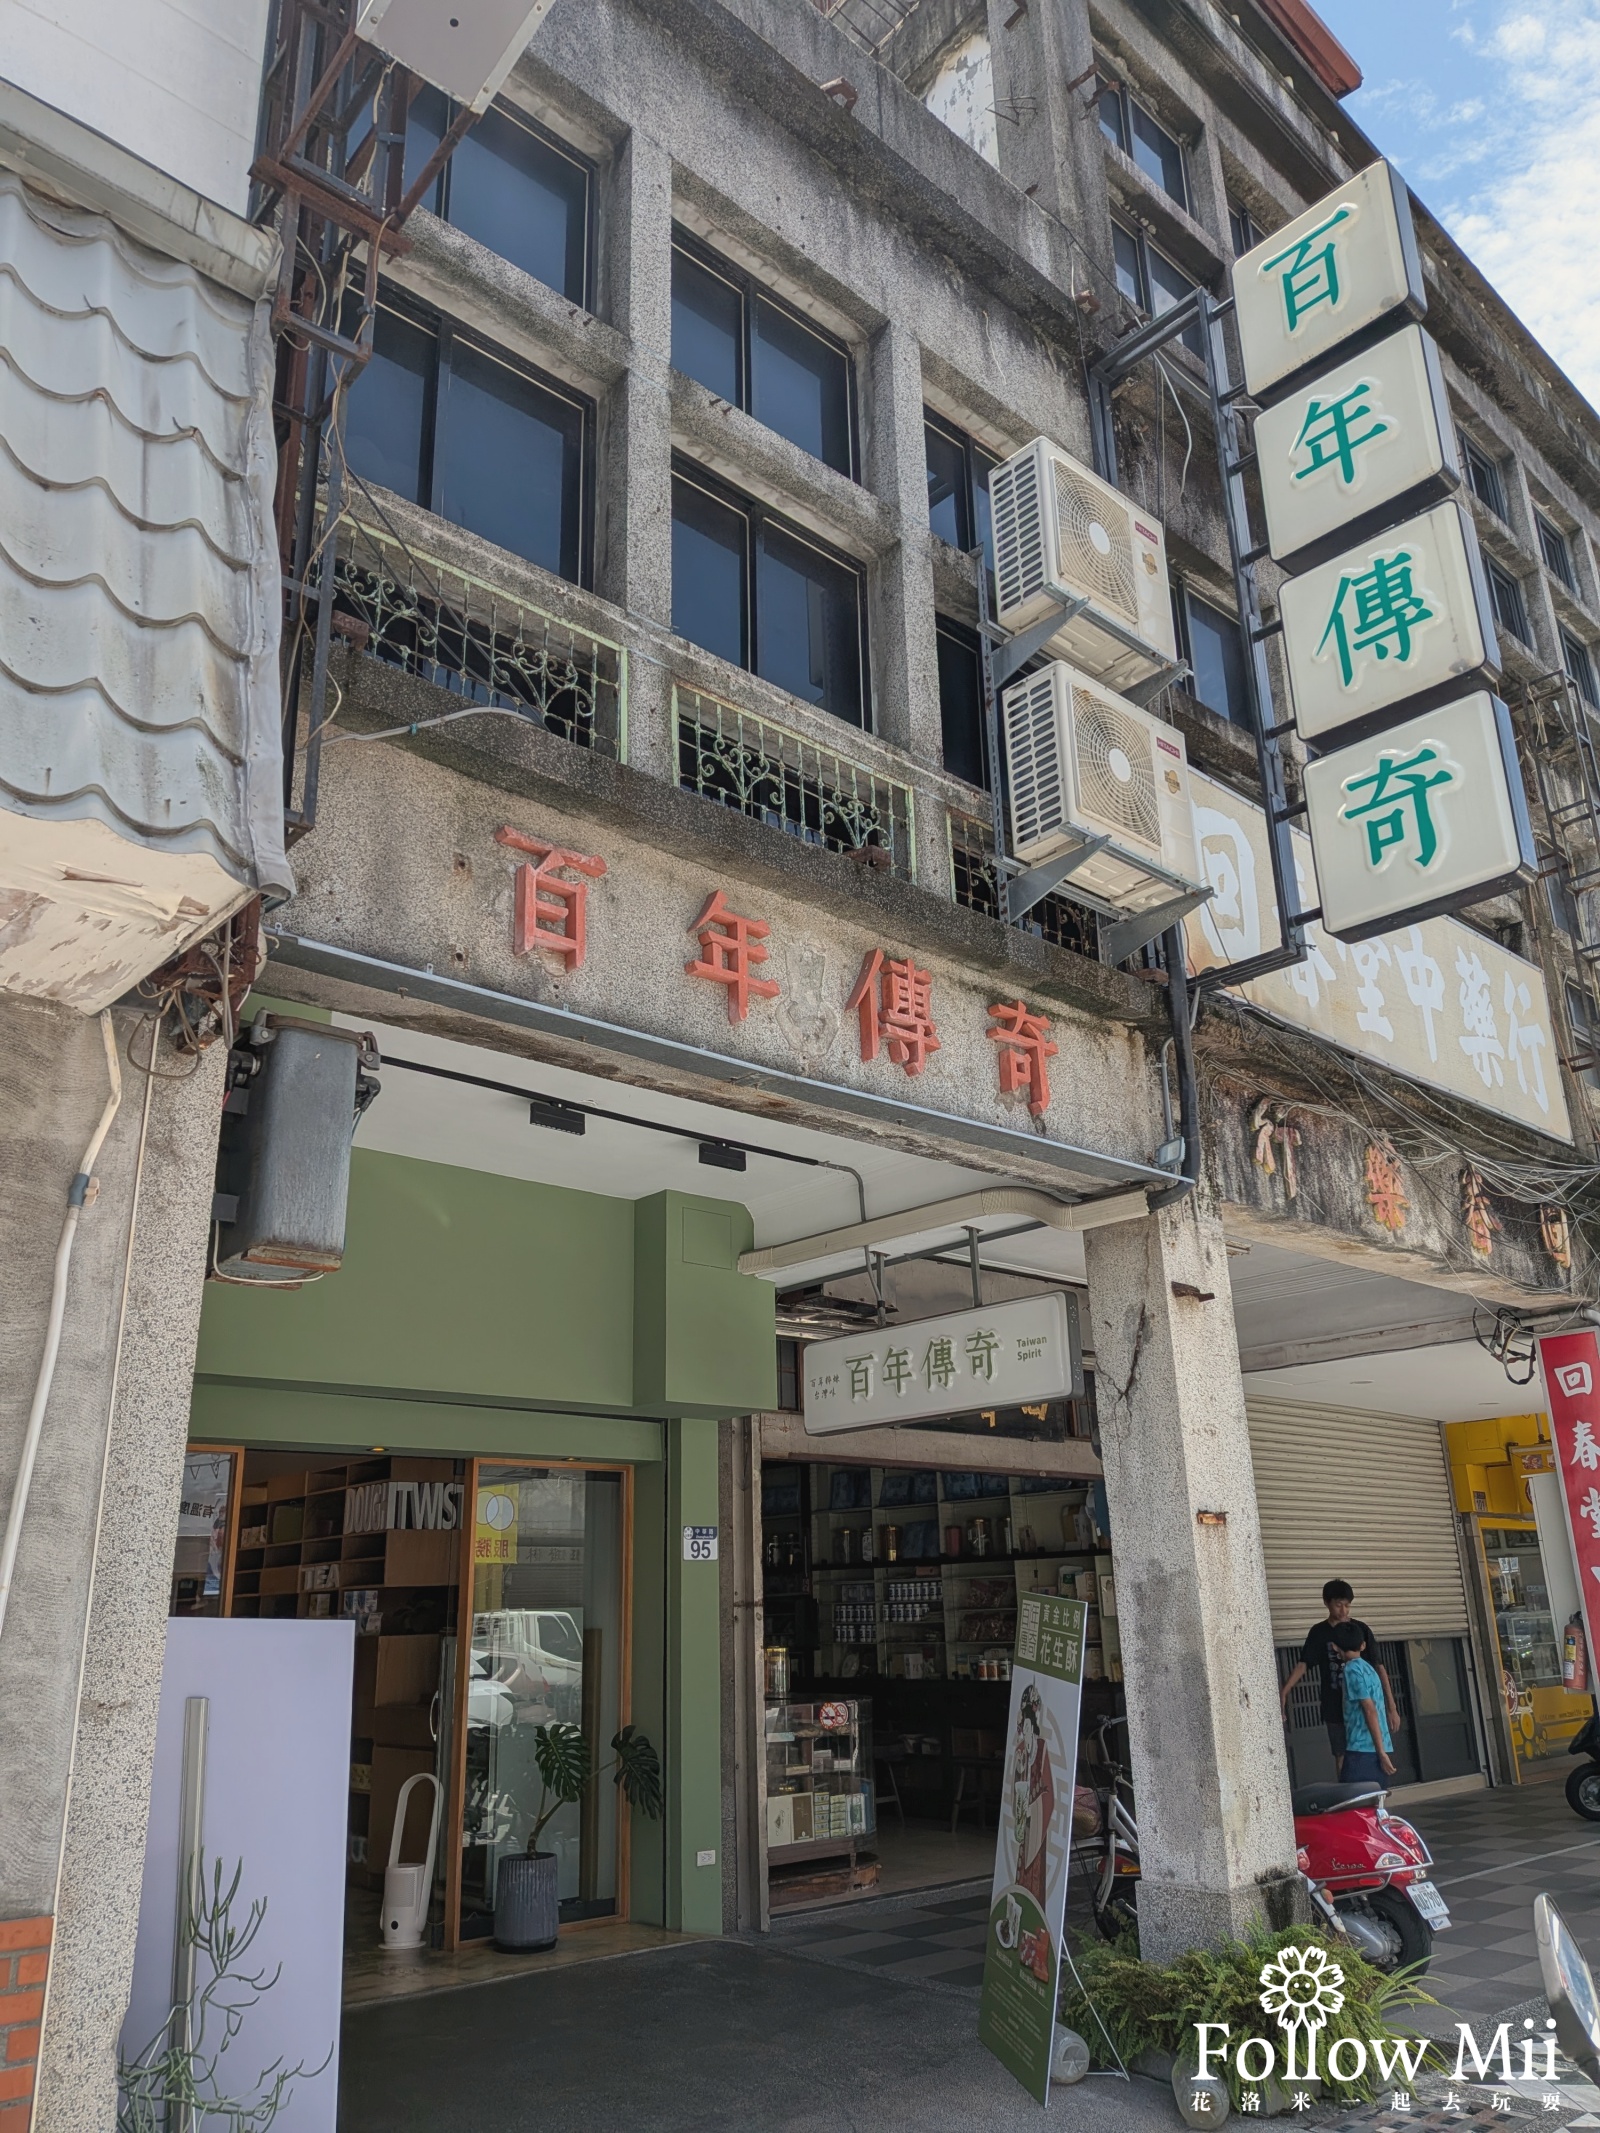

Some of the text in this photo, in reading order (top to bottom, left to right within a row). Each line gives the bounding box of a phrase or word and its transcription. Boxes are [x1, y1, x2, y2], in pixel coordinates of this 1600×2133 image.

[1264, 209, 1453, 868] 百年傳奇
[1157, 738, 1180, 758] HITACHI
[495, 825, 1058, 1116] 百年傳奇
[1016, 1335, 1048, 1348] Taiwan
[1017, 1348, 1042, 1361] Spirit
[845, 1330, 1000, 1400] 百年傳奇
[1554, 1361, 1600, 1583] 回春堂
[690, 1540, 711, 1559] 95
[301, 1564, 340, 1591] TEA
[1040, 1632, 1078, 1674] 花生酥
